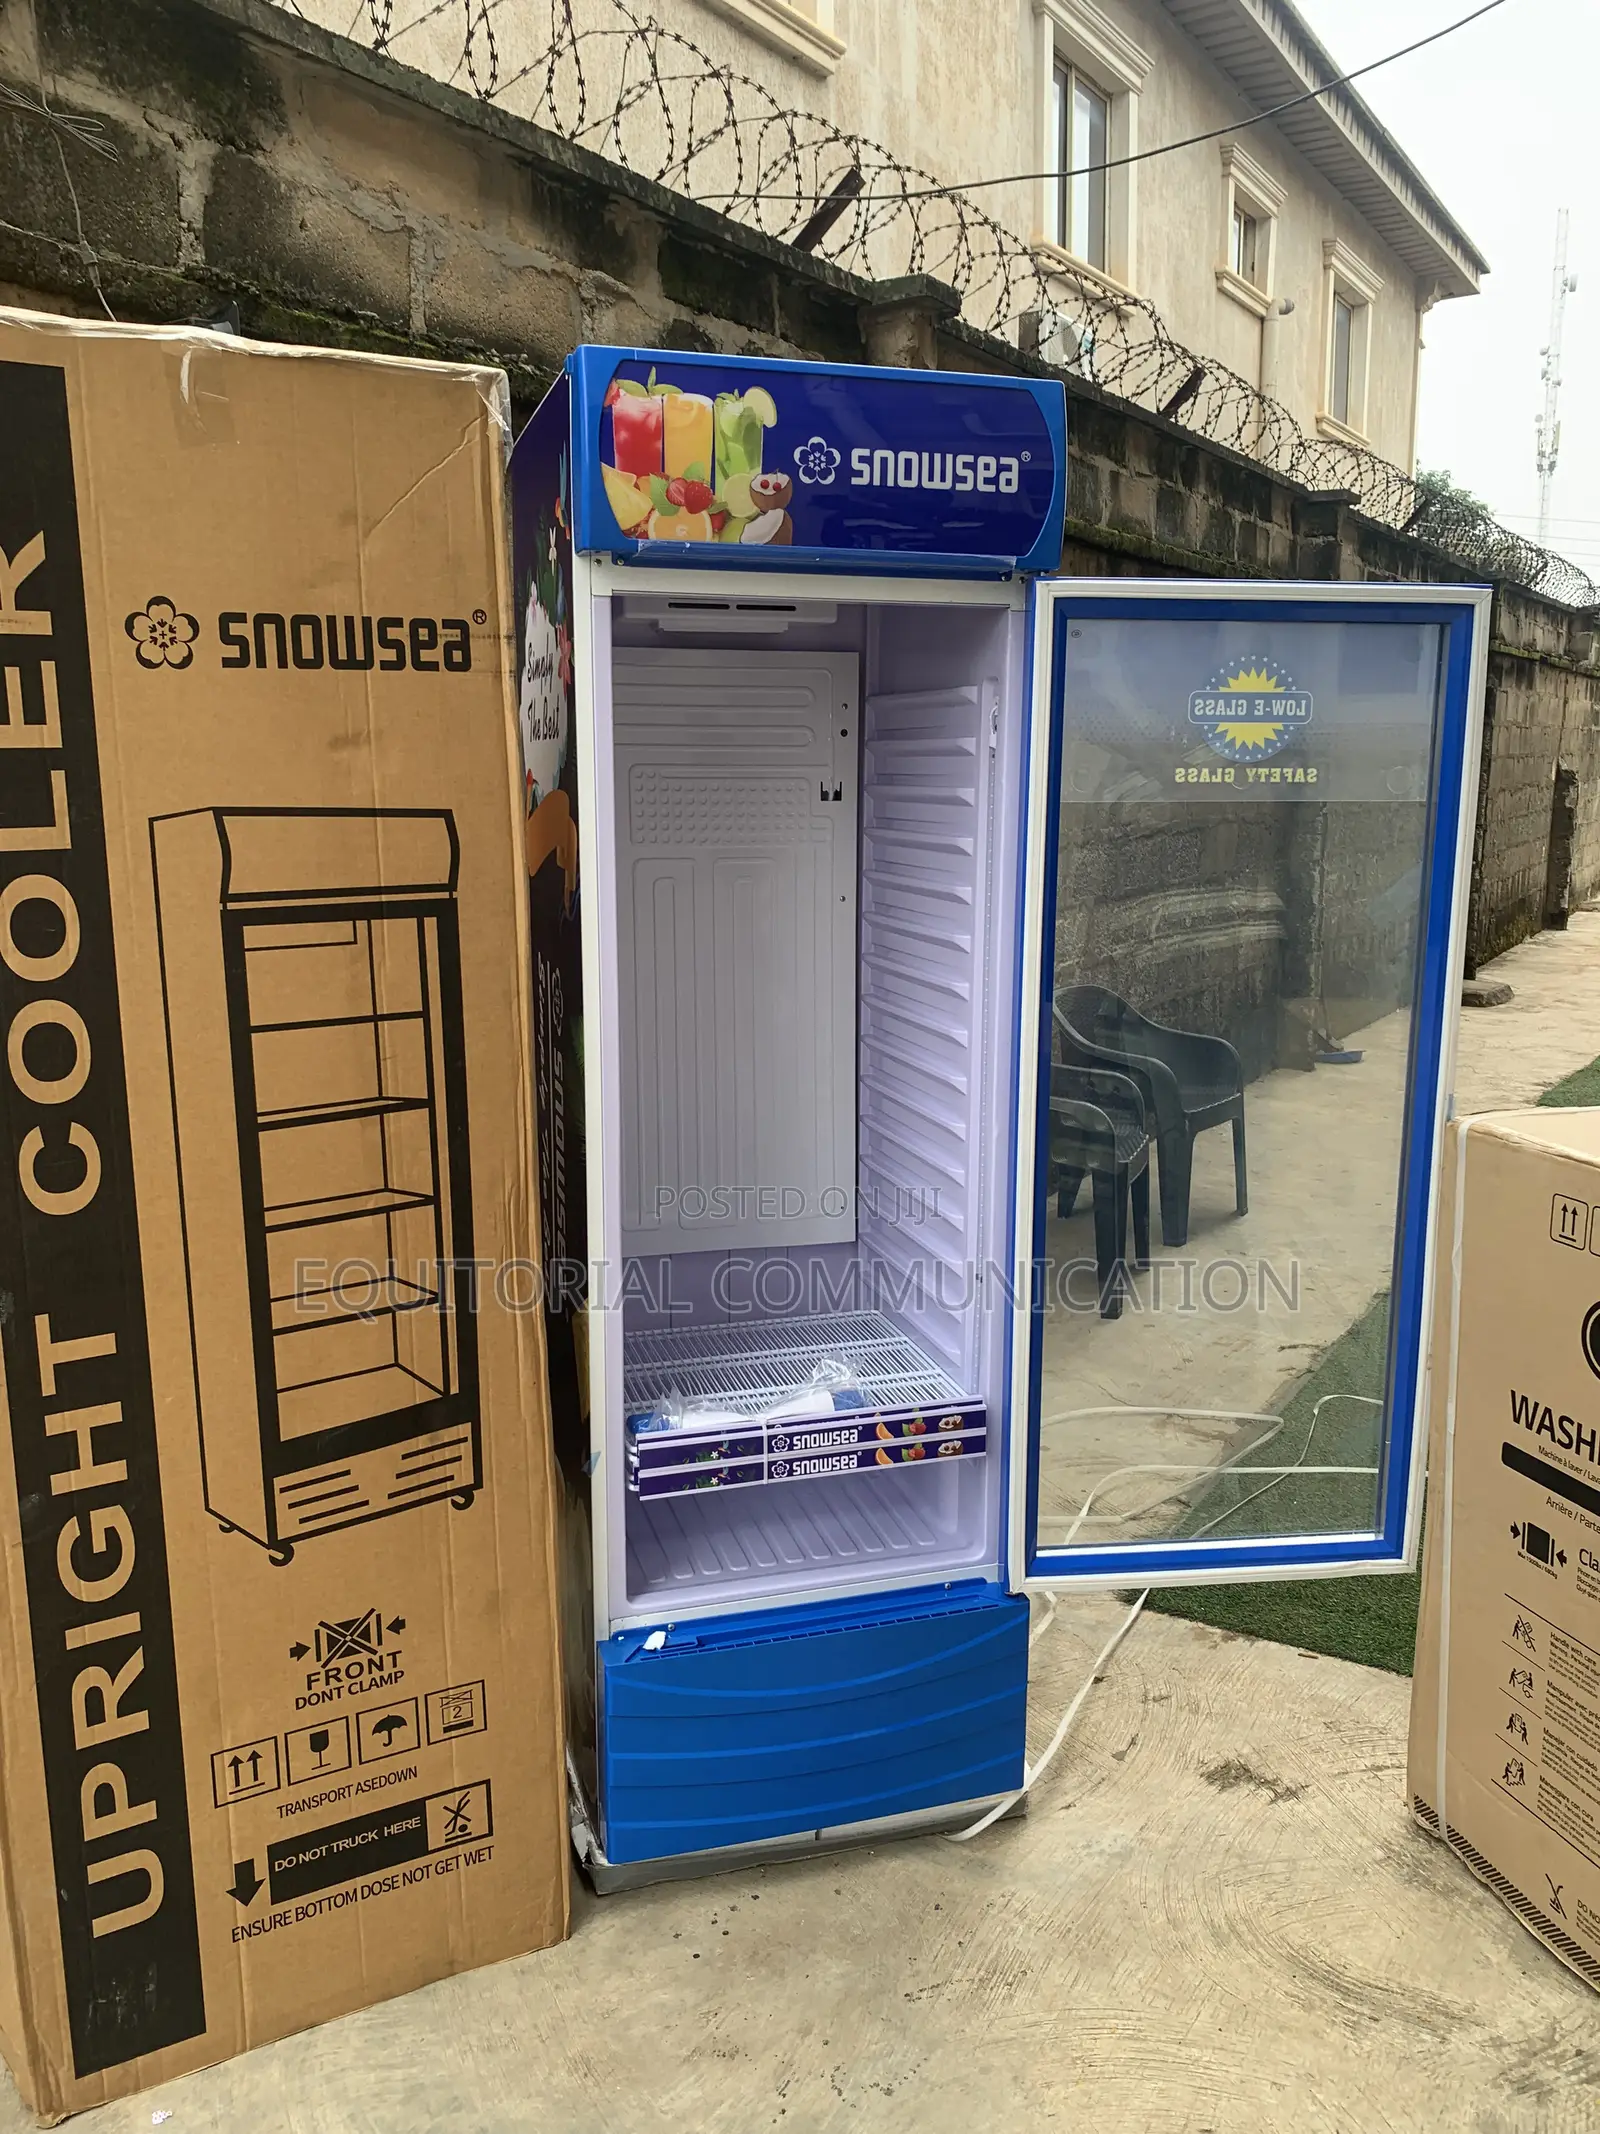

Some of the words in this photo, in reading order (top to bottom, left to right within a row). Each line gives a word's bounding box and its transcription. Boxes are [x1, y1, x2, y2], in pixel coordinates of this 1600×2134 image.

[527, 632, 553, 696] Simply
[528, 698, 541, 742] The
[542, 694, 559, 741] Best
[0, 530, 103, 1217] COOLER
[1538, 1445, 1563, 1465] Machine
[1546, 1494, 1572, 1519] Arrière
[36, 1314, 165, 1939] UPRIGHT
[295, 1685, 344, 1711] DONT
[347, 1670, 405, 1696] CLAMP
[306, 1650, 403, 1691] FRONT
[276, 1785, 353, 1819] TRANSPORT
[355, 1765, 418, 1796] ASEDOWN
[274, 1855, 297, 1872] DO
[299, 1845, 329, 1867] NOT
[330, 1830, 380, 1856] TRUCK
[384, 1816, 421, 1838] HERE
[231, 1910, 293, 1943] ENSURE
[294, 1888, 358, 1922] BOTTOM
[360, 1875, 400, 1899] DOSE
[402, 1863, 433, 1887] NOT
[435, 1855, 462, 1877] GET
[464, 1845, 495, 1867] WET
